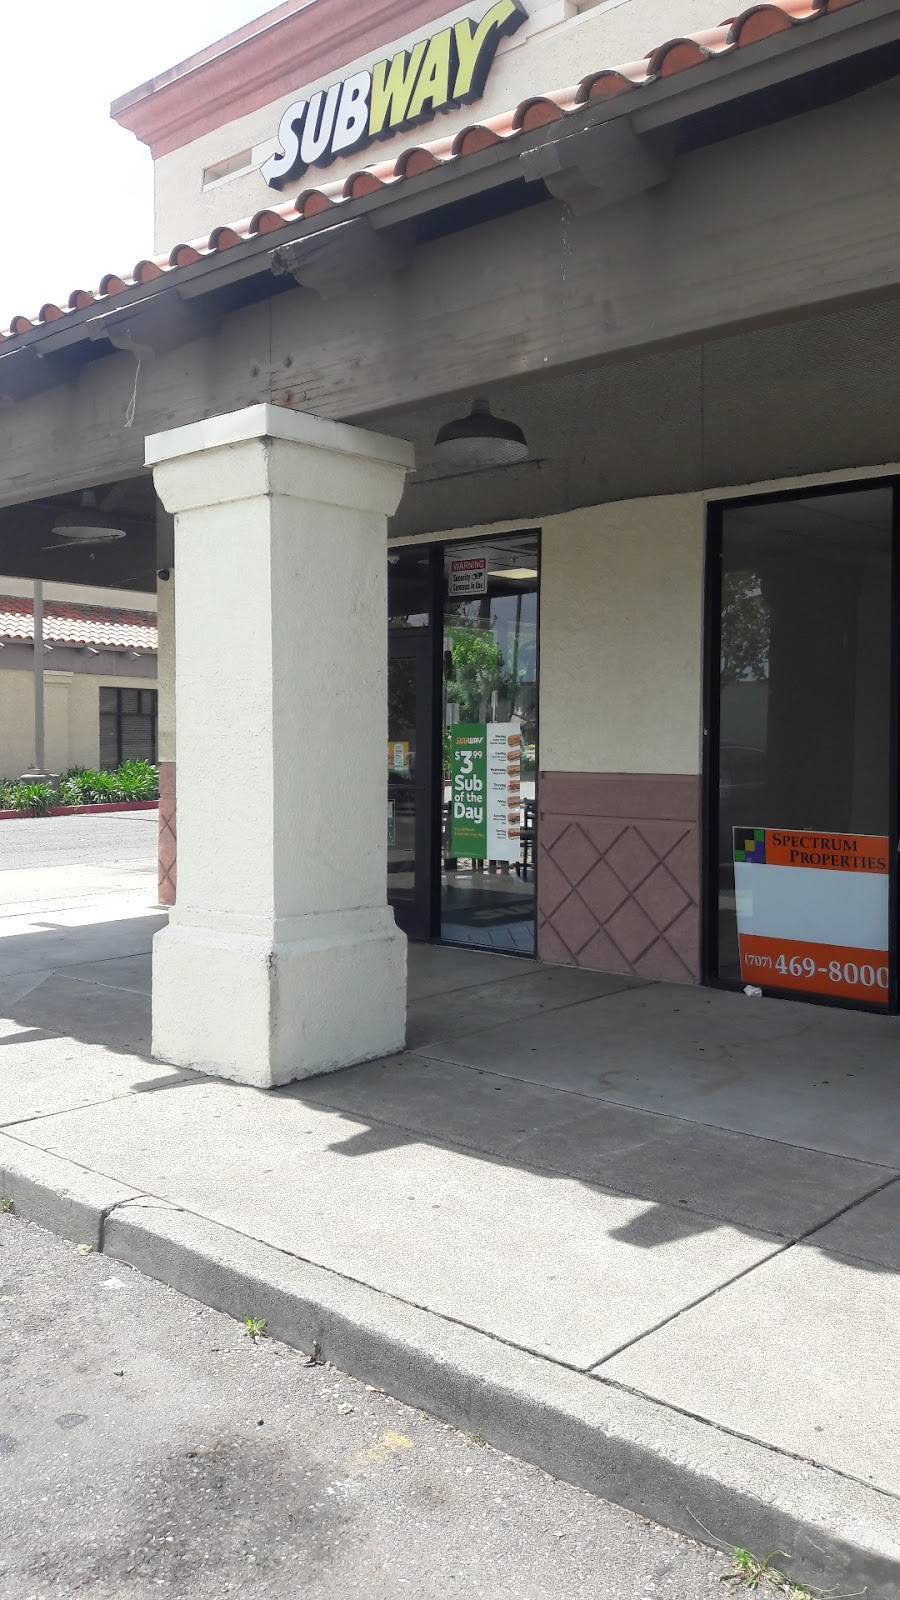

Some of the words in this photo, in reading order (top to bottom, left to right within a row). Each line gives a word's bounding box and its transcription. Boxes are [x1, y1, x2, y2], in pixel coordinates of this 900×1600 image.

[259, 0, 524, 189] SUBWAY
[453, 560, 484, 571] WARNING
[455, 737, 484, 745] SUBWAY
[454, 774, 483, 792] Sub
[454, 792, 465, 803] of
[467, 792, 483, 803] the
[453, 803, 483, 824] Day
[772, 831, 858, 852] SPECTRUM
[790, 849, 887, 870] PROPERTIES
[744, 953, 772, 968] (707)
[774, 952, 889, 989] 469-8000
